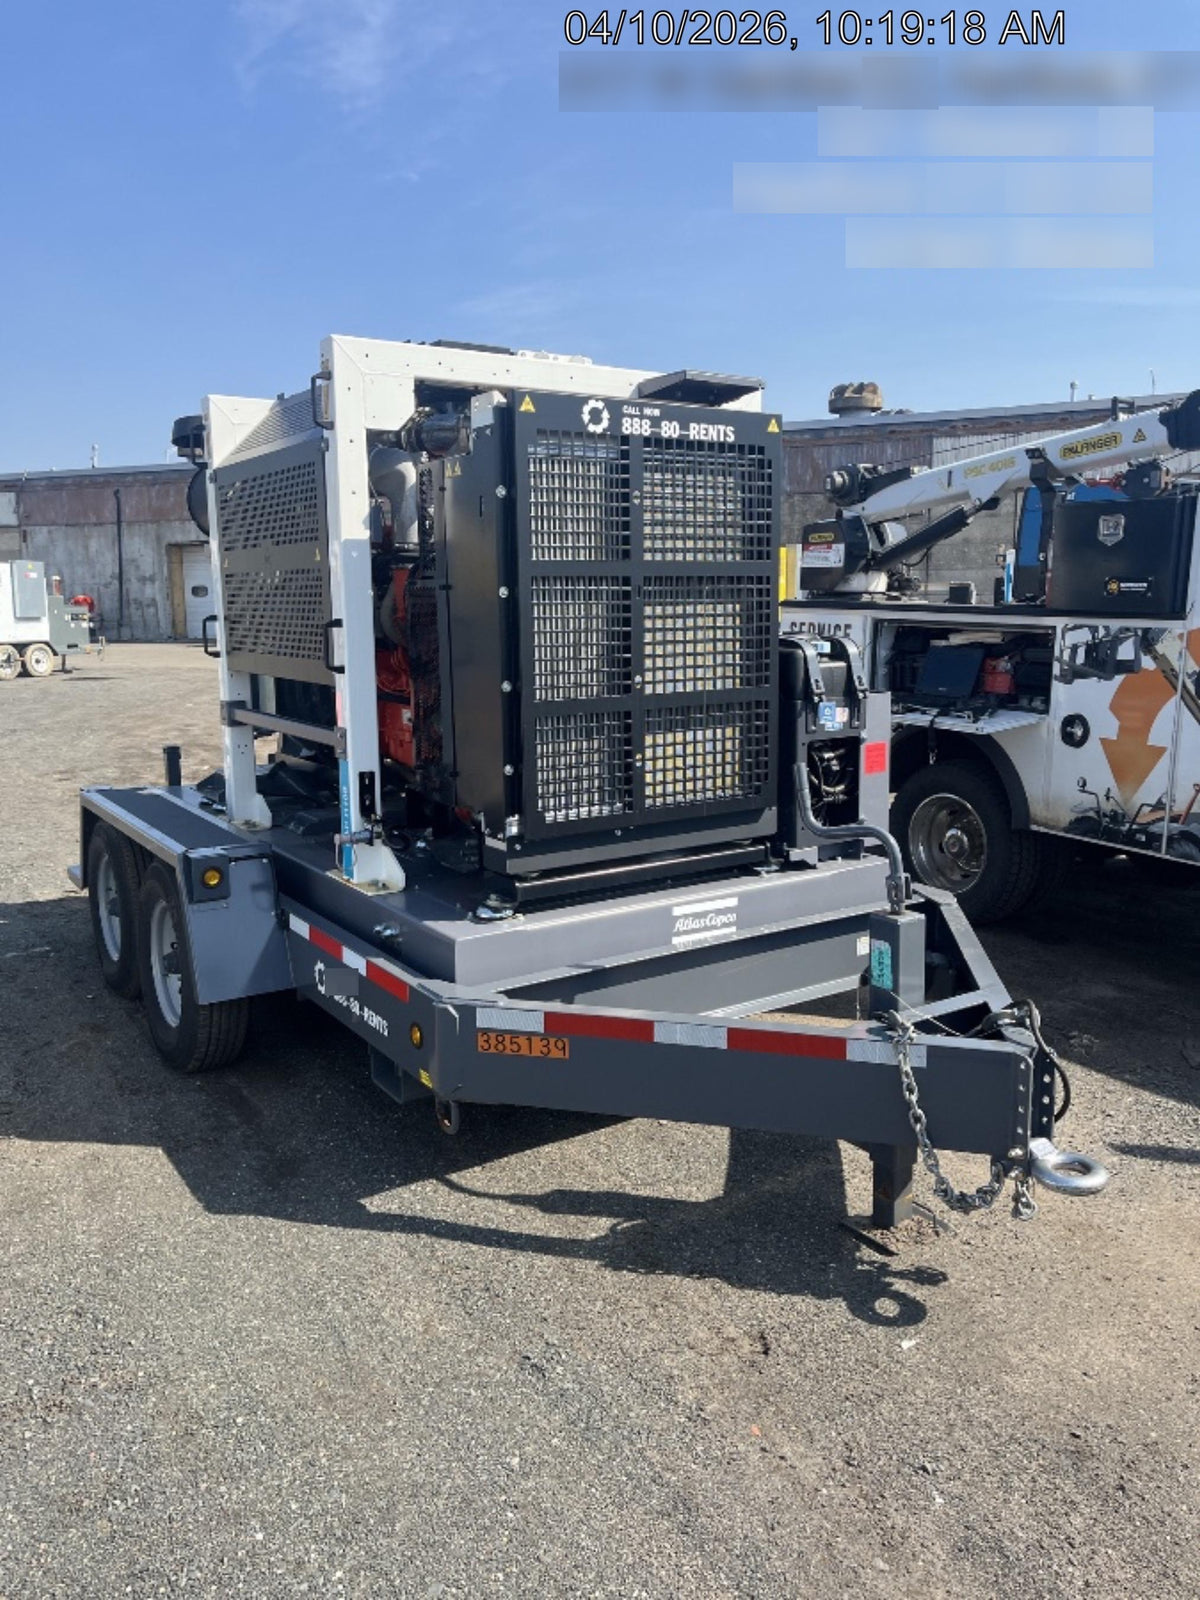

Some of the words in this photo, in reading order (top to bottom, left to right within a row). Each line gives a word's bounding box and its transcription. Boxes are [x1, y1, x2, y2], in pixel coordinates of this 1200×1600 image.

[622, 405, 640, 415] CALL
[643, 407, 660, 416] NOW
[480, 1032, 566, 1056] 385139
